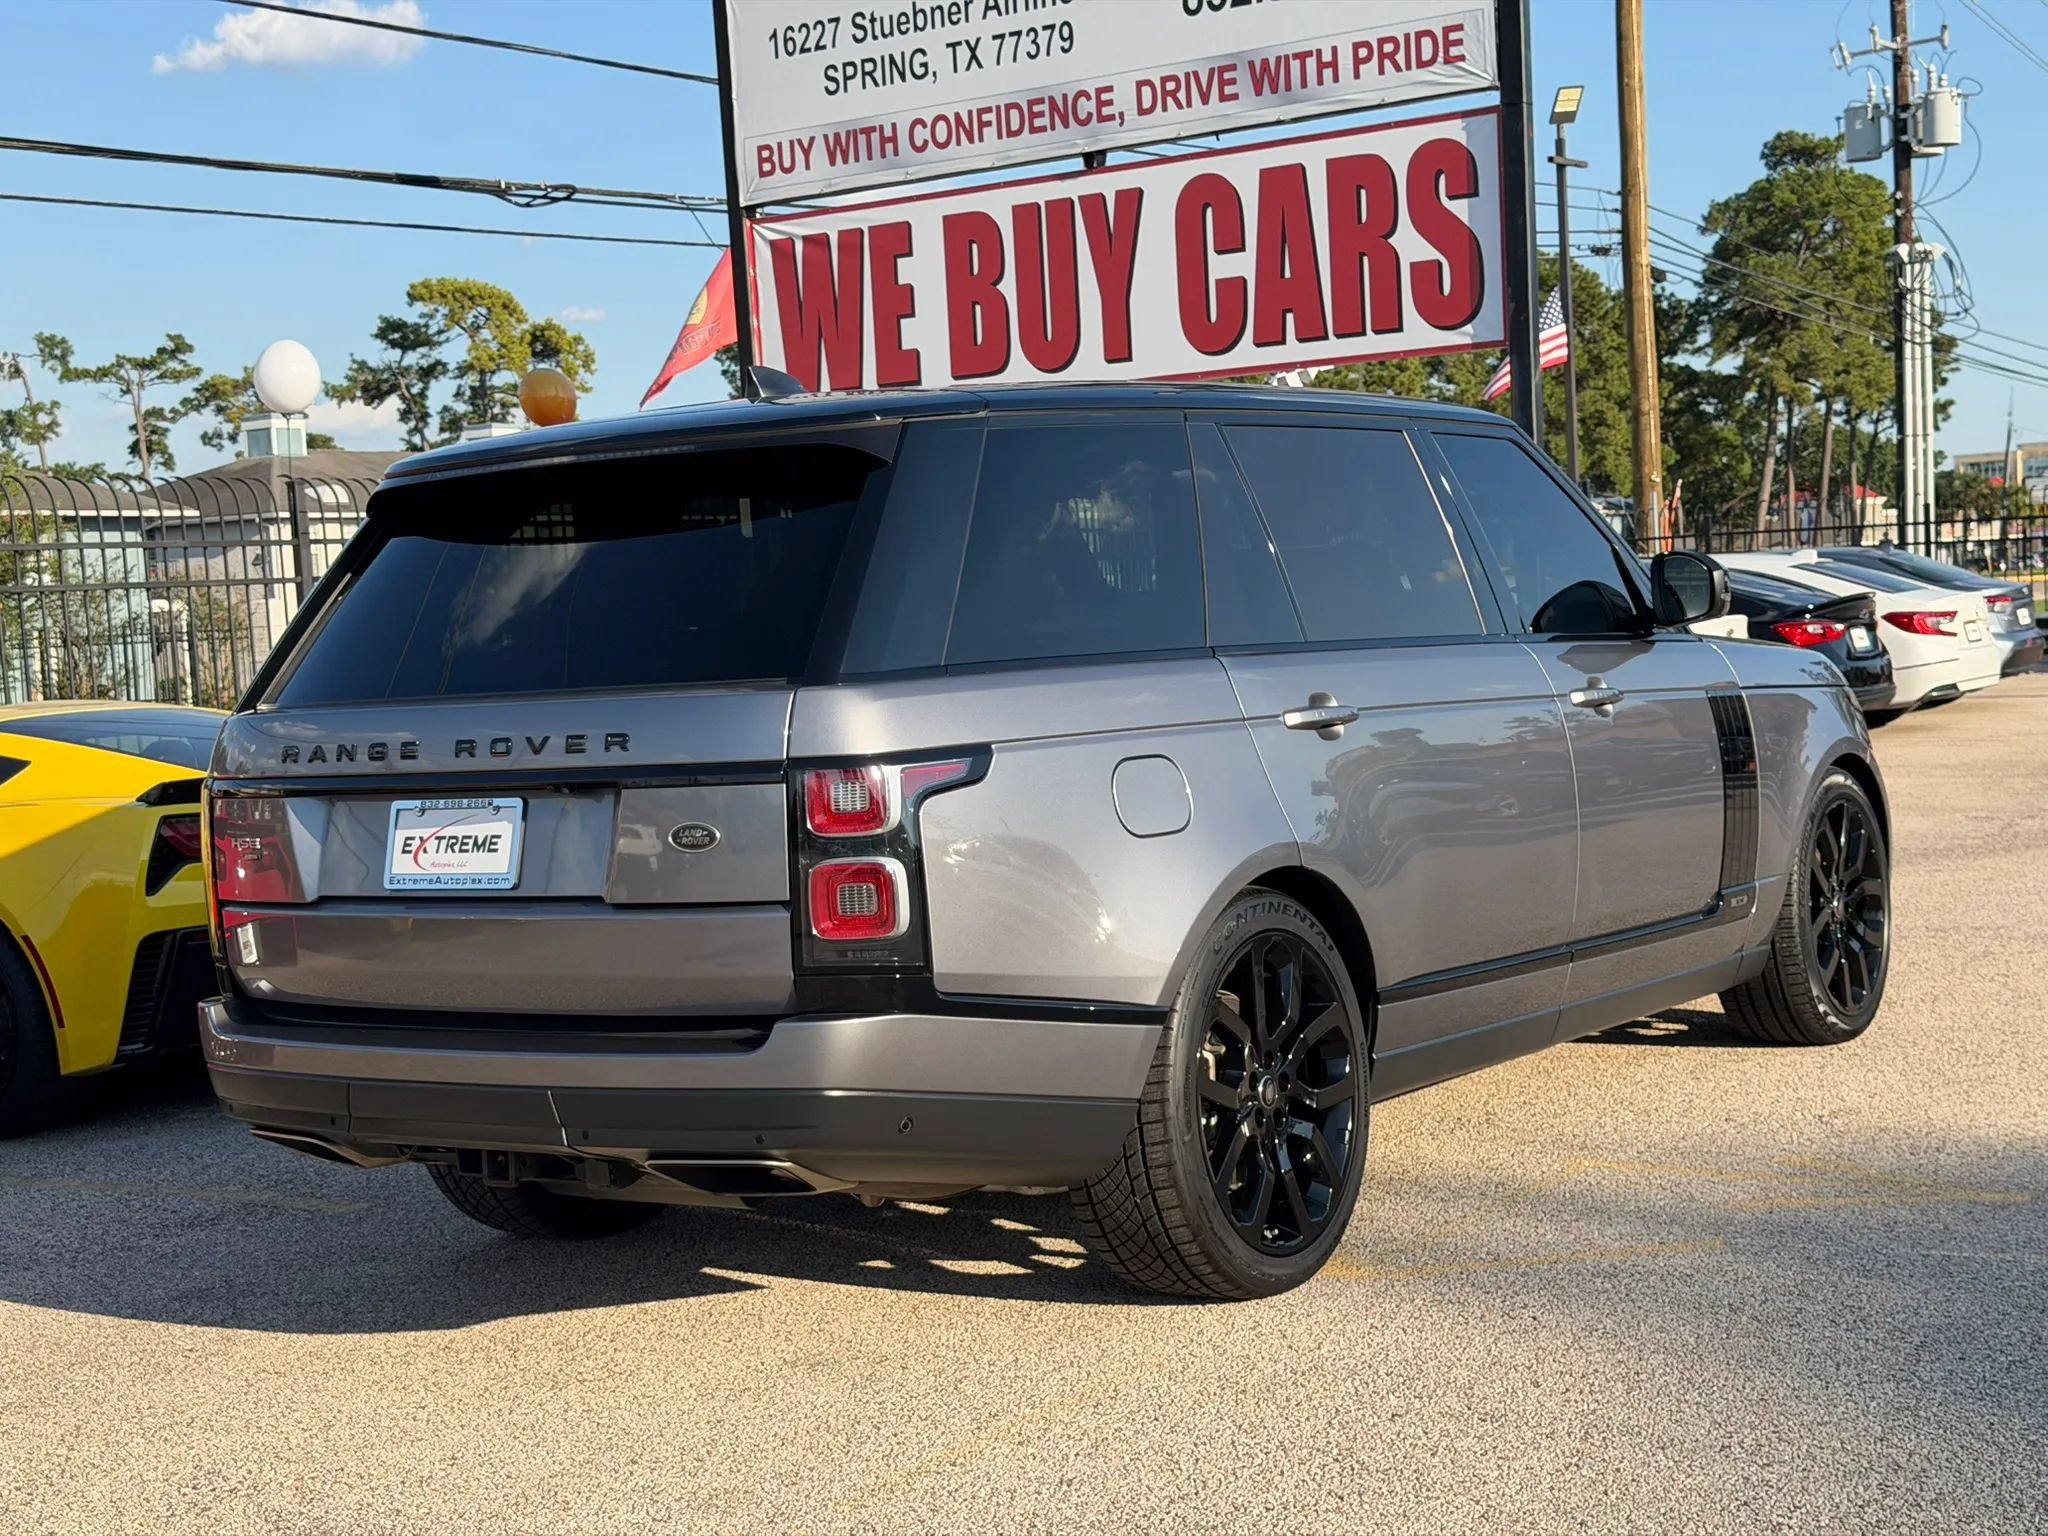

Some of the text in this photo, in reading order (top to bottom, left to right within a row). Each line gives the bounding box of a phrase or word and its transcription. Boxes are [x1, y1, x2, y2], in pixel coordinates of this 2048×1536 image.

[769, 17, 842, 59] 16227
[850, 0, 974, 44] Stuebner
[823, 20, 1074, 96] SPRING, TX 77379
[756, 23, 1465, 178] BUY WITH CONFIDENCE, DRIVE WITH PRIDE
[769, 137, 1486, 393] WE BUY CARS
[280, 732, 631, 765] RANGE ROVER
[232, 837, 261, 849] HSE
[401, 834, 502, 855] EXTREME
[679, 828, 702, 837] LAND
[681, 836, 710, 845] ROVER
[388, 875, 511, 886] ExtremeAutoplex.com
